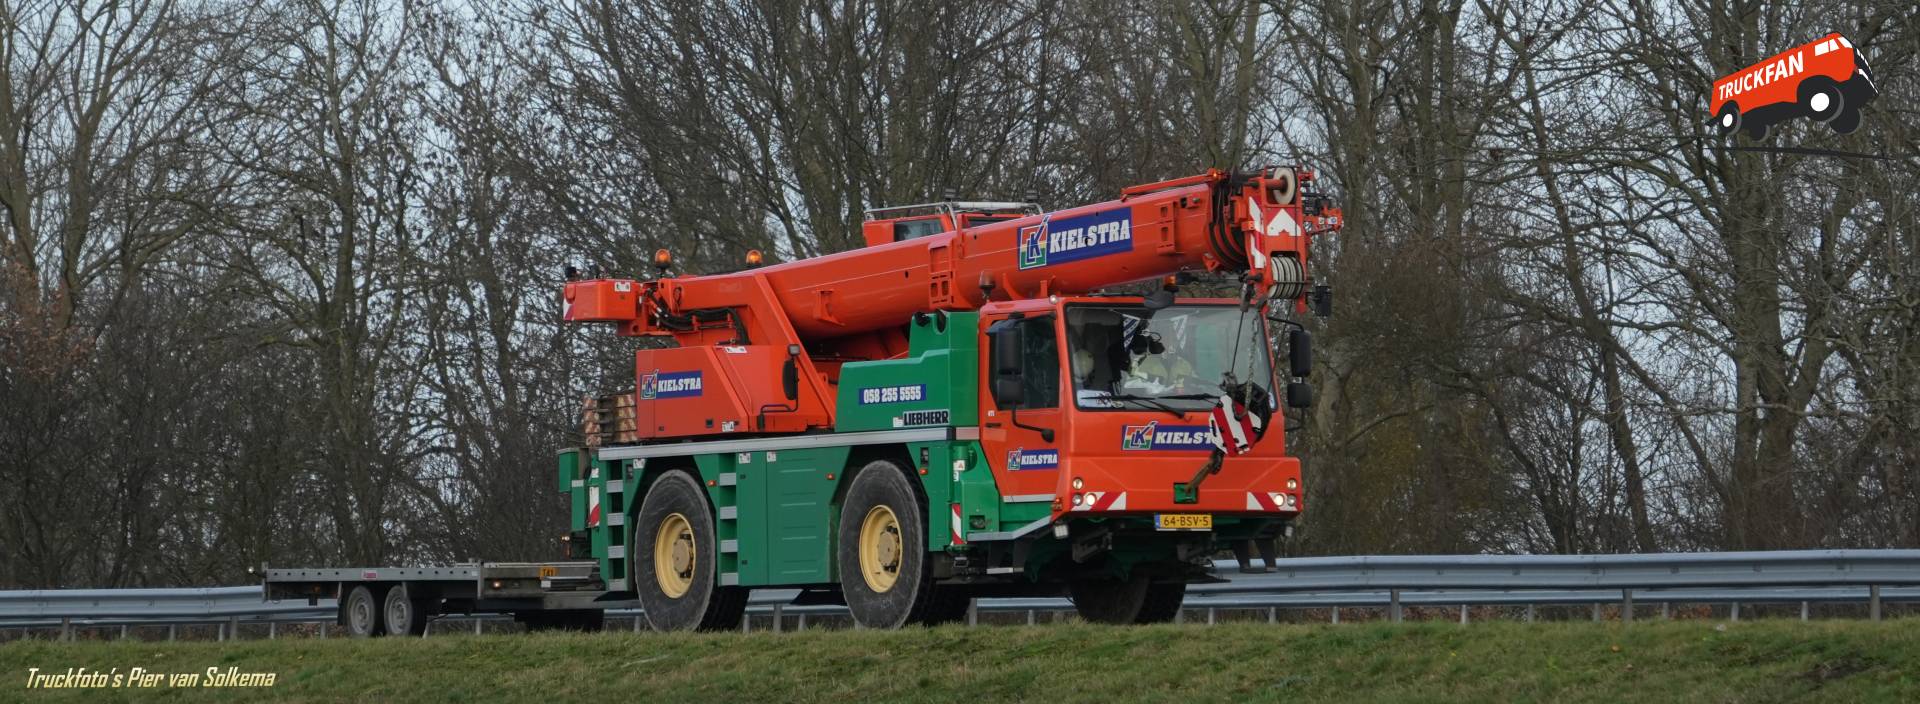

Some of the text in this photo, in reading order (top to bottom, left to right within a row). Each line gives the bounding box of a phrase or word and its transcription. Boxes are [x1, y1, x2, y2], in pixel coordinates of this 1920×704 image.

[1049, 219, 1131, 253] KIELSTRA
[657, 377, 702, 392] KIELSTRA
[863, 385, 921, 404] 058 255 5555
[903, 410, 949, 426] LIEBHERR
[1155, 431, 1213, 444] KIELST
[1021, 454, 1058, 465] KIELSTRA
[1163, 515, 1209, 526] 64-BSV-5
